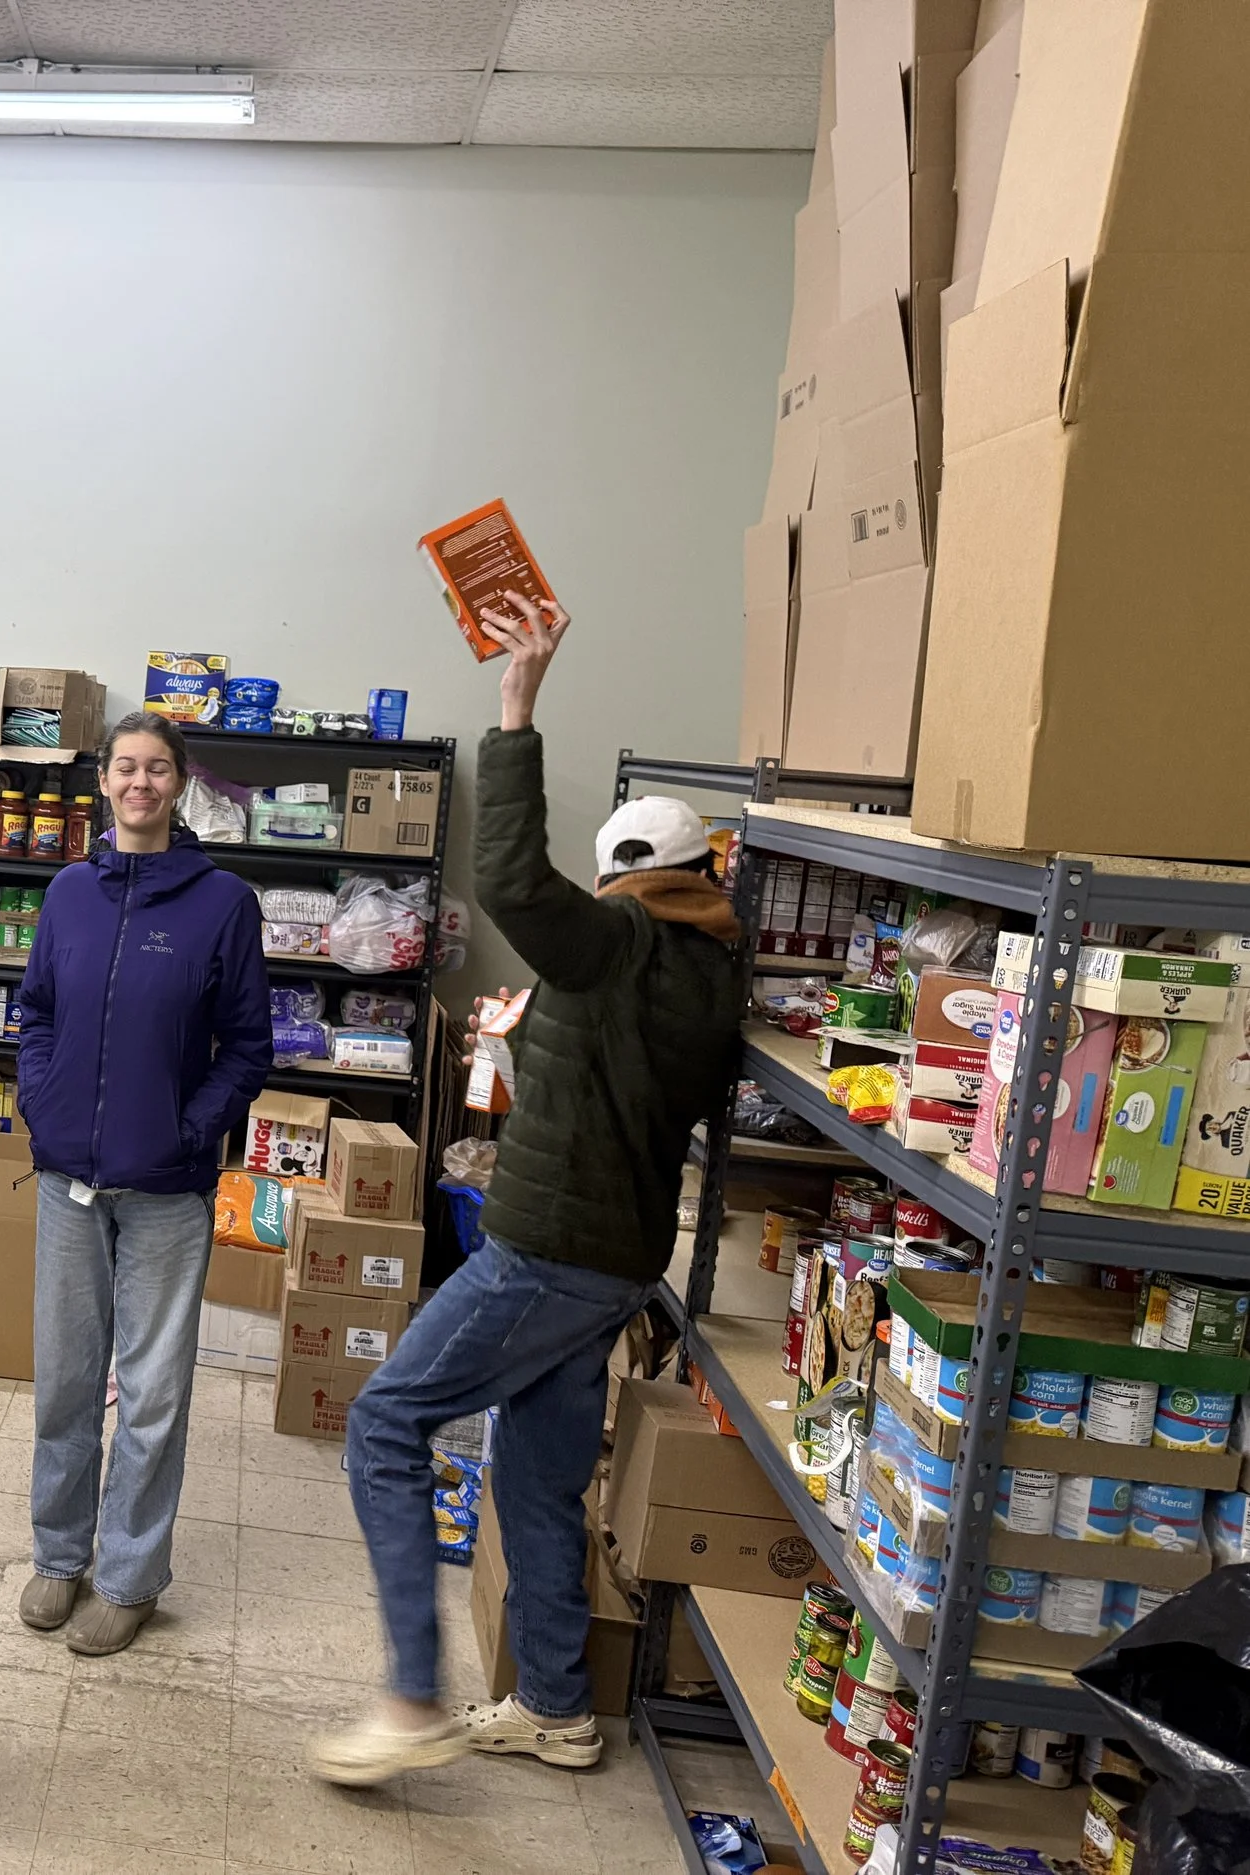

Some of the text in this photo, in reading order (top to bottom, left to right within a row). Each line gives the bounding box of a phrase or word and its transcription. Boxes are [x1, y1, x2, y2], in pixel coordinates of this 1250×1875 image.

[166, 675, 204, 692] always
[363, 773, 381, 782] Count
[356, 798, 366, 812] G
[1161, 963, 1195, 972] CINNAMON
[1160, 986, 1192, 996] QUAKER
[951, 1001, 975, 1011] Sugar
[961, 1009, 987, 1019] Maple
[955, 1072, 983, 1084] UAKER
[1231, 1105, 1250, 1156] QUAKER
[1198, 1188, 1221, 1209] 20
[1226, 1181, 1246, 1216] VALUE
[256, 1181, 279, 1236] Assurance
[311, 1267, 342, 1276] FRAGILE
[295, 1341, 326, 1349] FRAGILE
[1032, 1381, 1066, 1394] whole
[1123, 1382, 1141, 1390] Facts
[1030, 1389, 1055, 1402] corn
[1175, 1395, 1194, 1406] food
[1200, 1410, 1223, 1421] corn
[1015, 1469, 1044, 1480] Nutrition
[1161, 1496, 1192, 1510] kernel
[808, 1676, 828, 1693] Peppers
